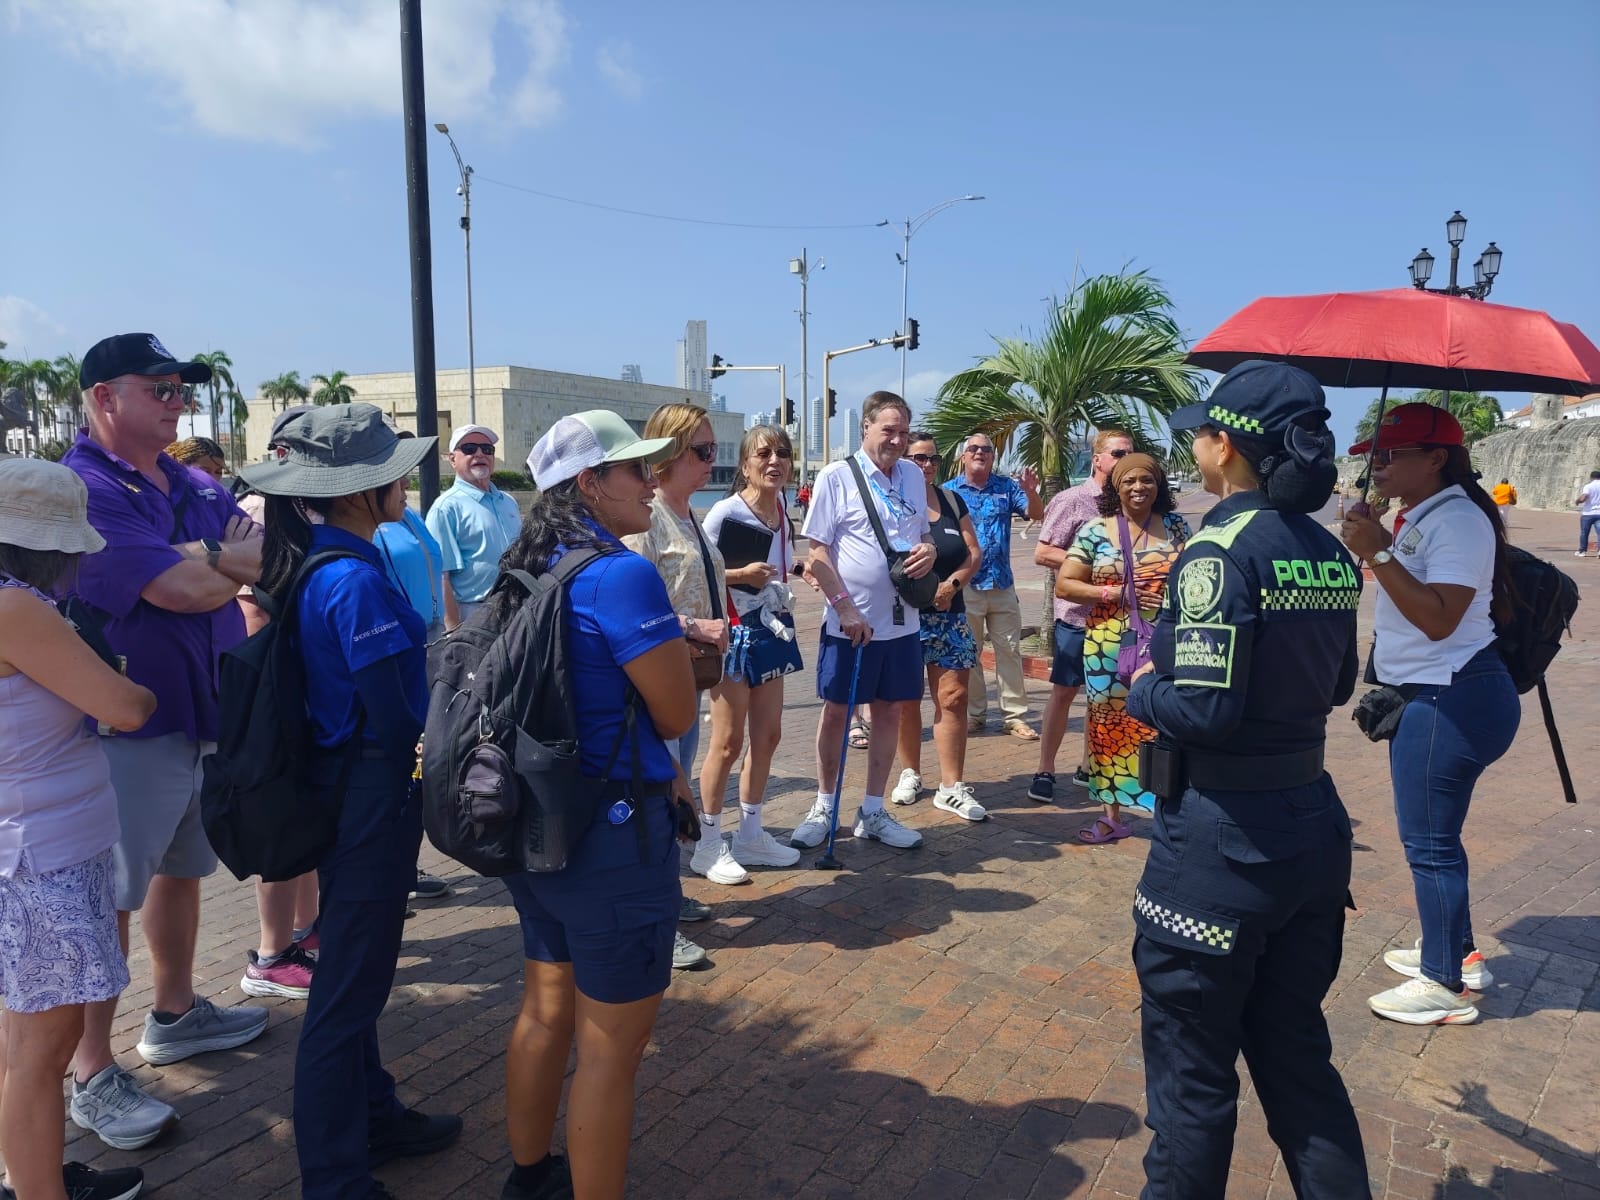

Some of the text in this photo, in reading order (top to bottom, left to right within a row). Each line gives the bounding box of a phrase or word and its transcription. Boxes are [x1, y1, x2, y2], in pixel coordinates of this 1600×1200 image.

[1272, 551, 1358, 588] POLICÍA
[1217, 642, 1225, 654] Y
[761, 662, 796, 684] FILA
